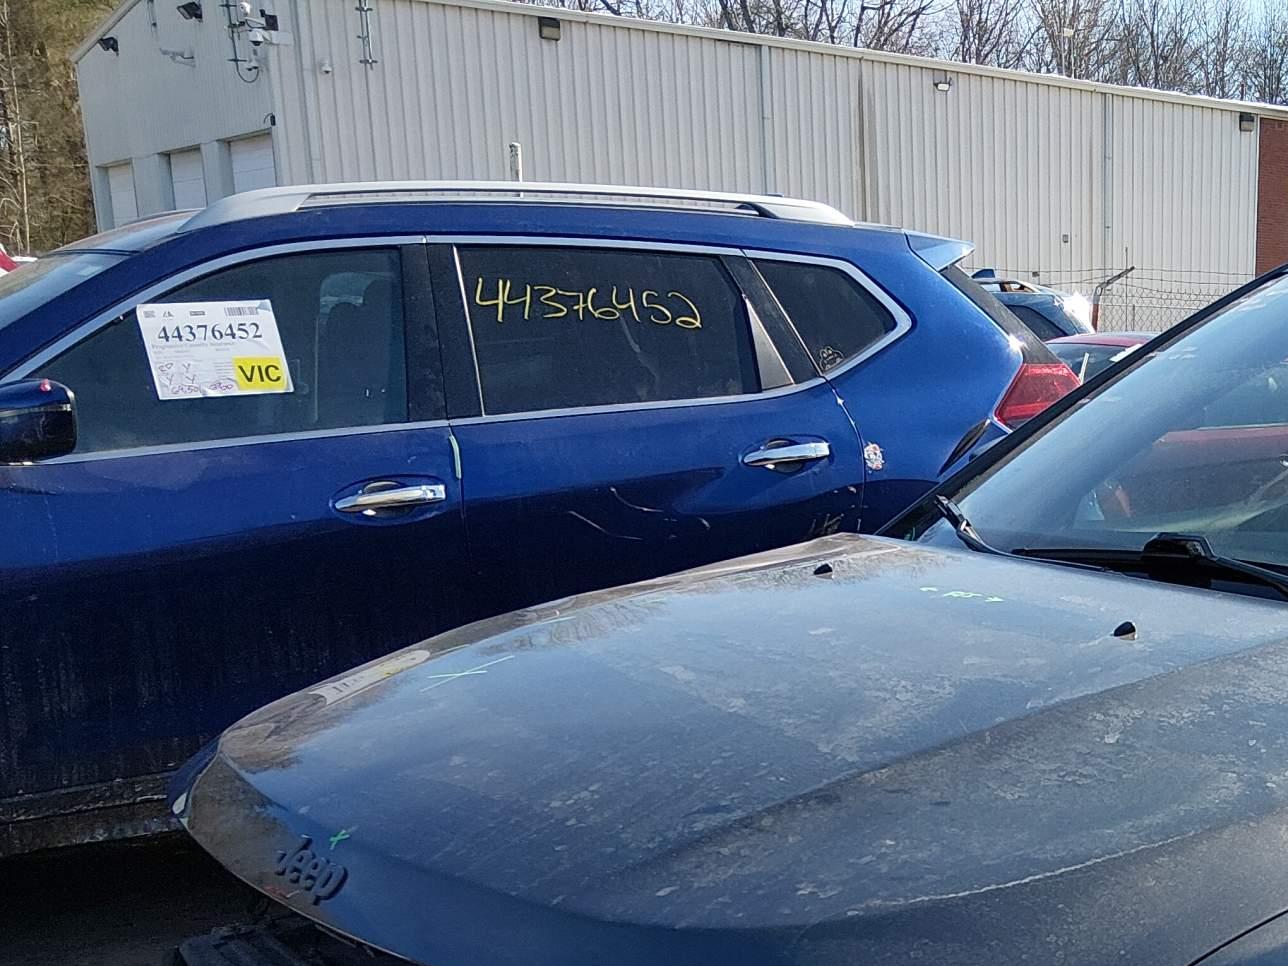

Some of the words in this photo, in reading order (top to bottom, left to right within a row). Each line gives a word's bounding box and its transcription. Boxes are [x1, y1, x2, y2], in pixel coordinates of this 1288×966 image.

[475, 277, 702, 328] 44376452
[157, 322, 263, 342] 44376452
[238, 364, 282, 383] VIC
[274, 833, 349, 906] Jeep
